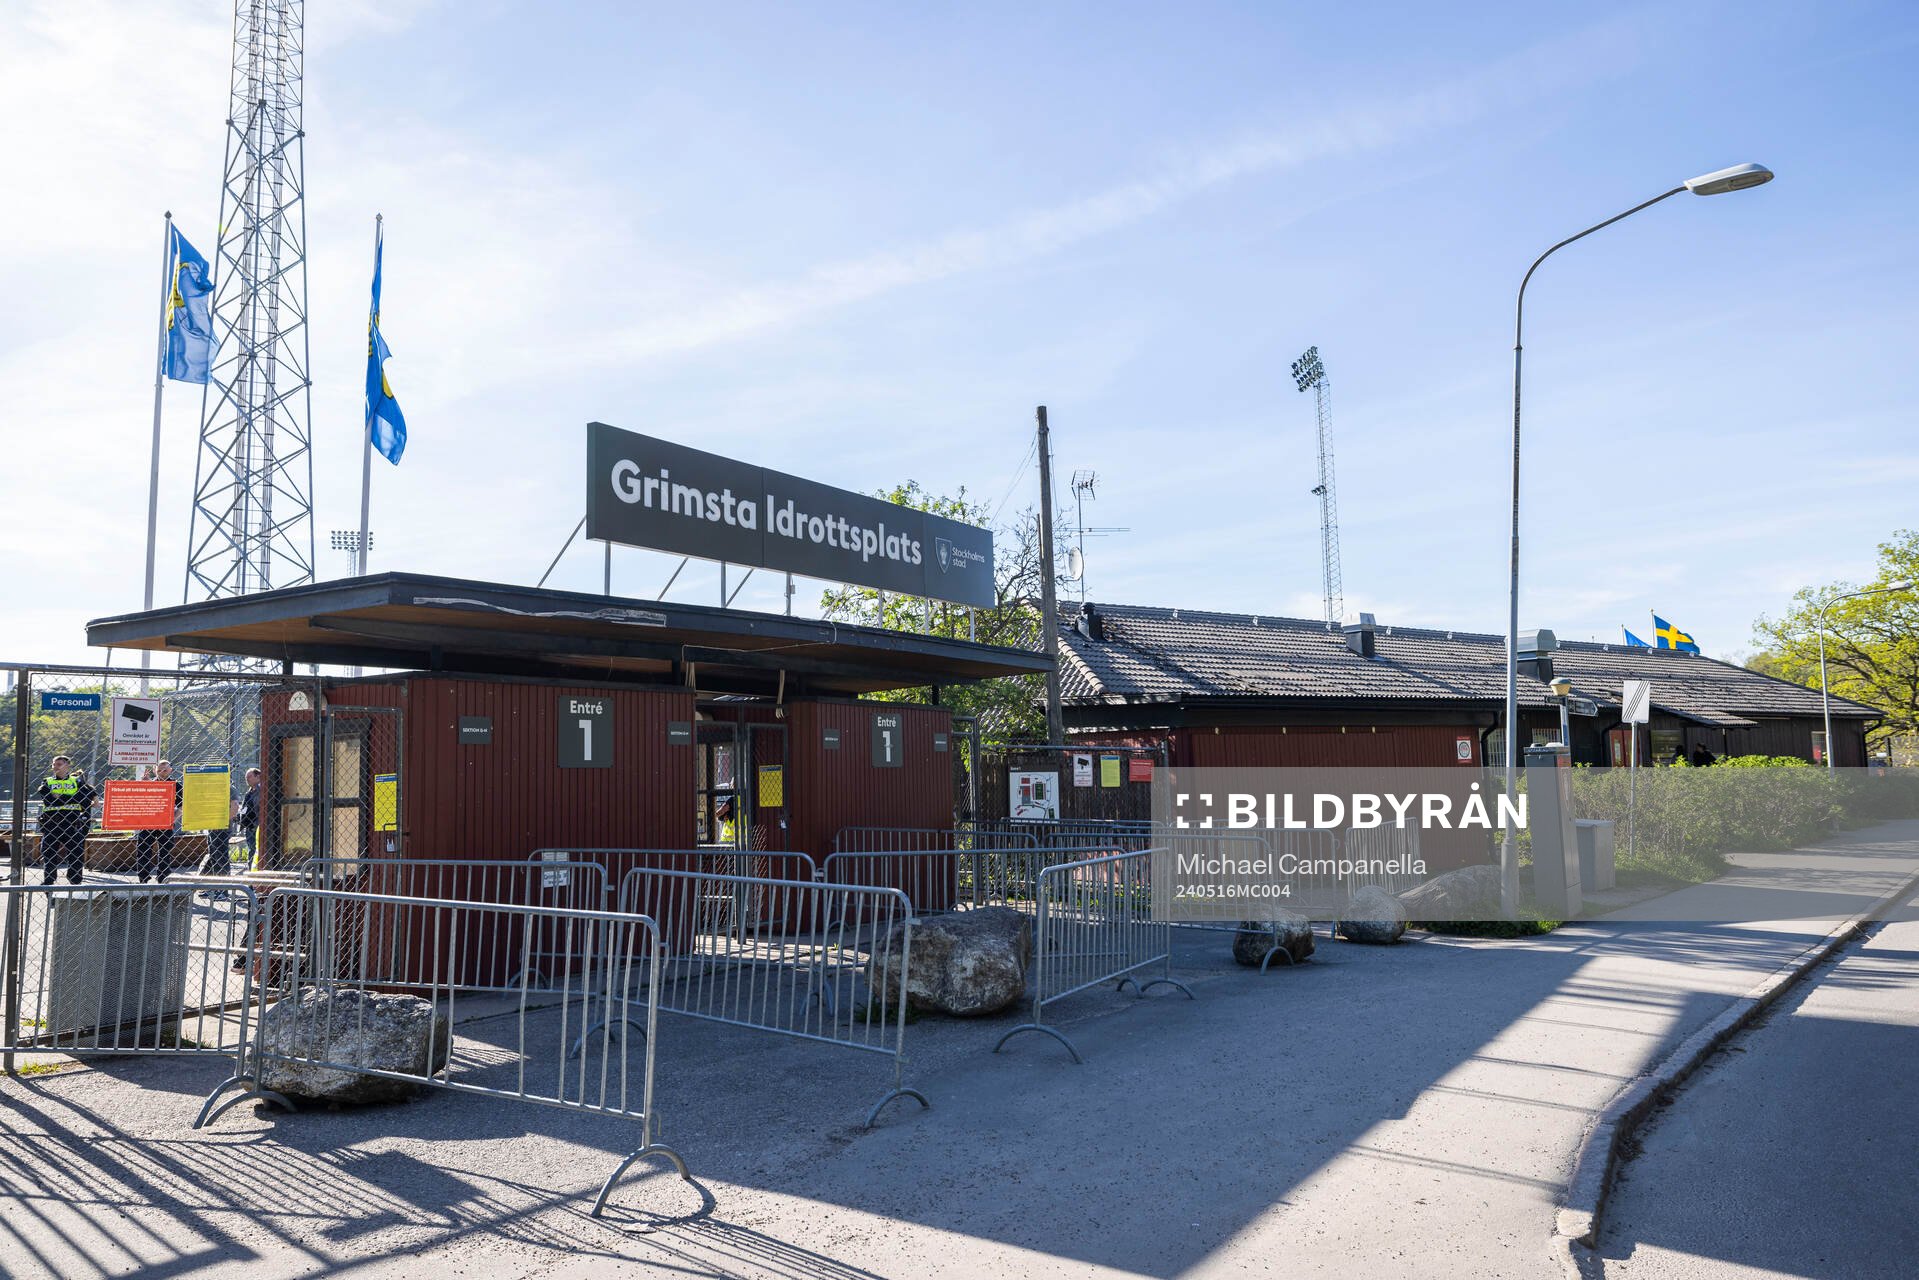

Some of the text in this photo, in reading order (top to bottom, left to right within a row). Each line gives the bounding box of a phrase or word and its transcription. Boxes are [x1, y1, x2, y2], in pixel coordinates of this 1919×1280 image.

[610, 459, 922, 566] Grimsta Idrottsplats
[952, 546, 985, 563] Stockholms
[952, 558, 967, 569] stad
[51, 697, 92, 707] Personal
[569, 700, 603, 715] Entré
[877, 716, 897, 728] Entré
[578, 719, 593, 761] 1
[882, 730, 892, 763] 1
